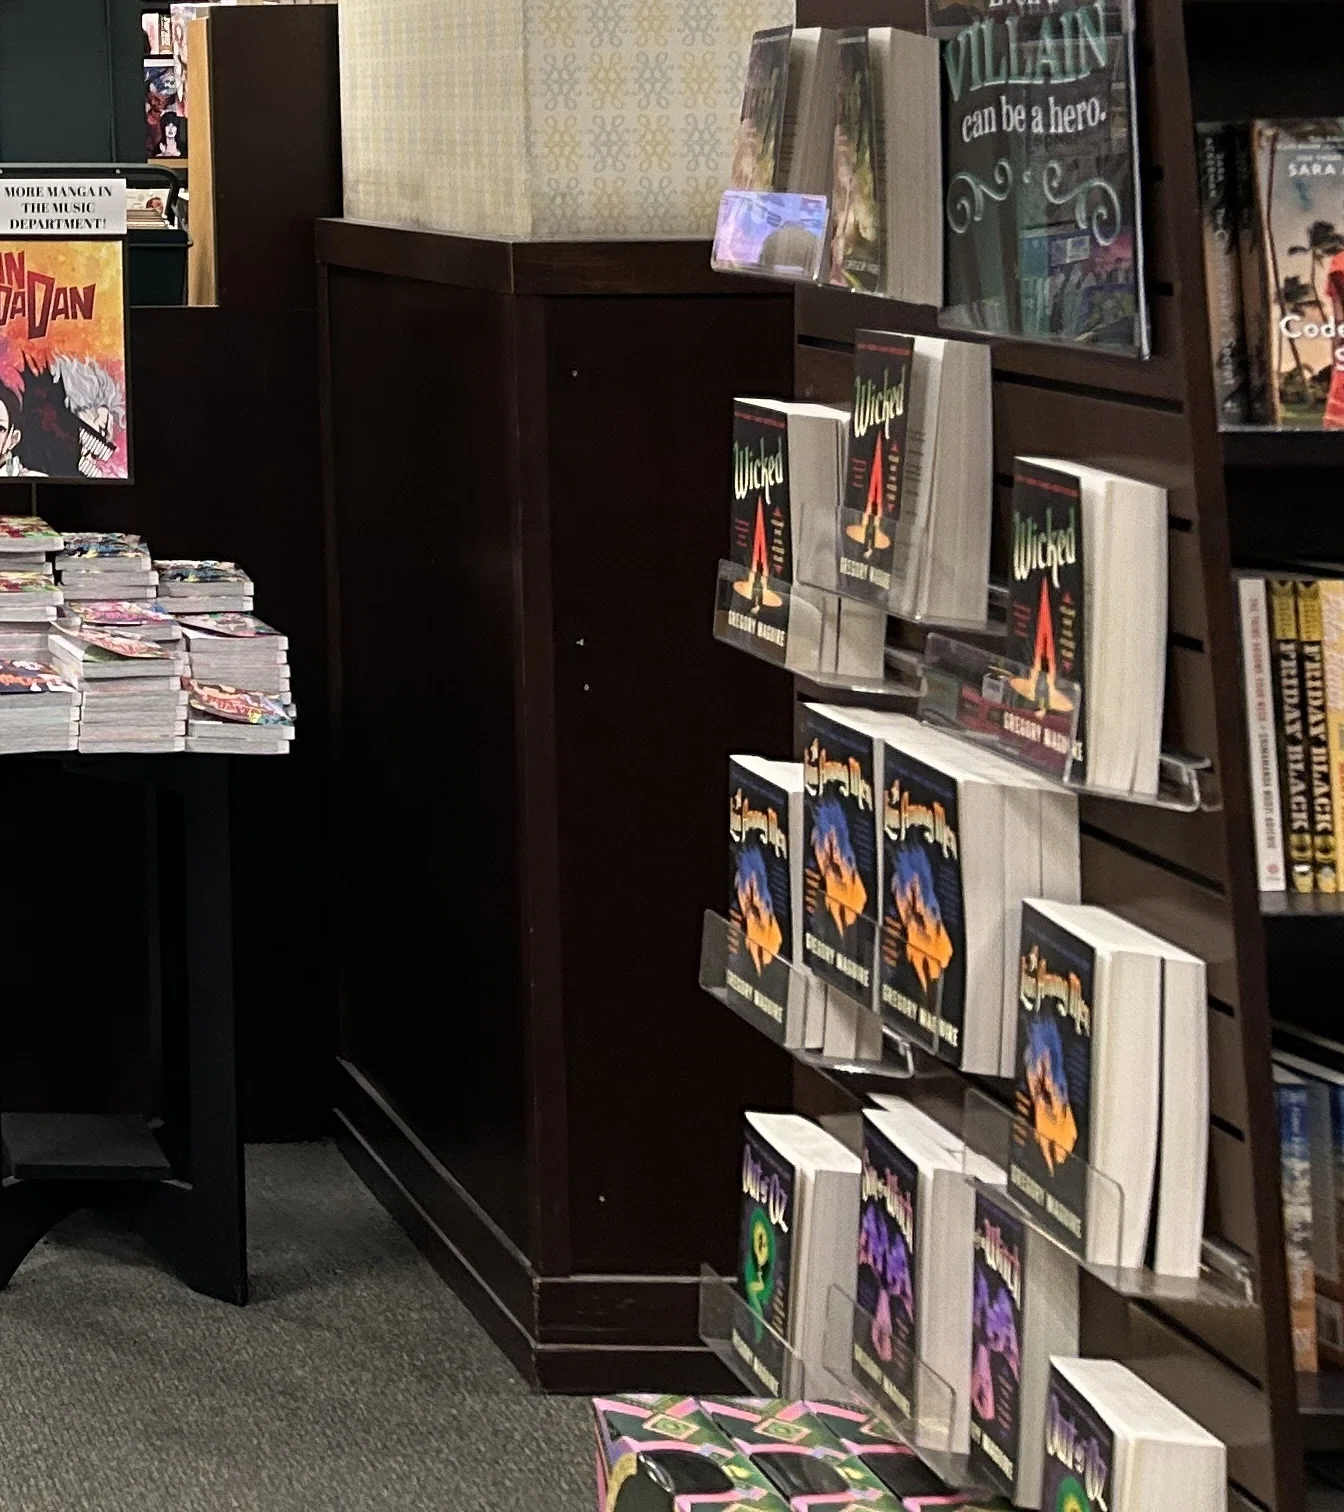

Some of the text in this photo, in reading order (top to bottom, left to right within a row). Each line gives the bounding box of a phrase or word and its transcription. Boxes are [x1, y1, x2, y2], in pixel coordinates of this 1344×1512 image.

[962, 95, 1107, 143] can be a hero.
[4, 184, 113, 198] MORE MANGA IN
[1288, 162, 1337, 178] SARA
[9, 217, 108, 231] DEPARTMENT!
[22, 202, 95, 214] THE MUSIC
[853, 362, 907, 440] Wicked
[732, 435, 784, 505] Wicked
[1012, 506, 1077, 589] Wicked
[1302, 641, 1327, 741] FRIDAY
[1278, 641, 1310, 833] FRIDAY BLACK
[1311, 743, 1335, 834] BLACK
